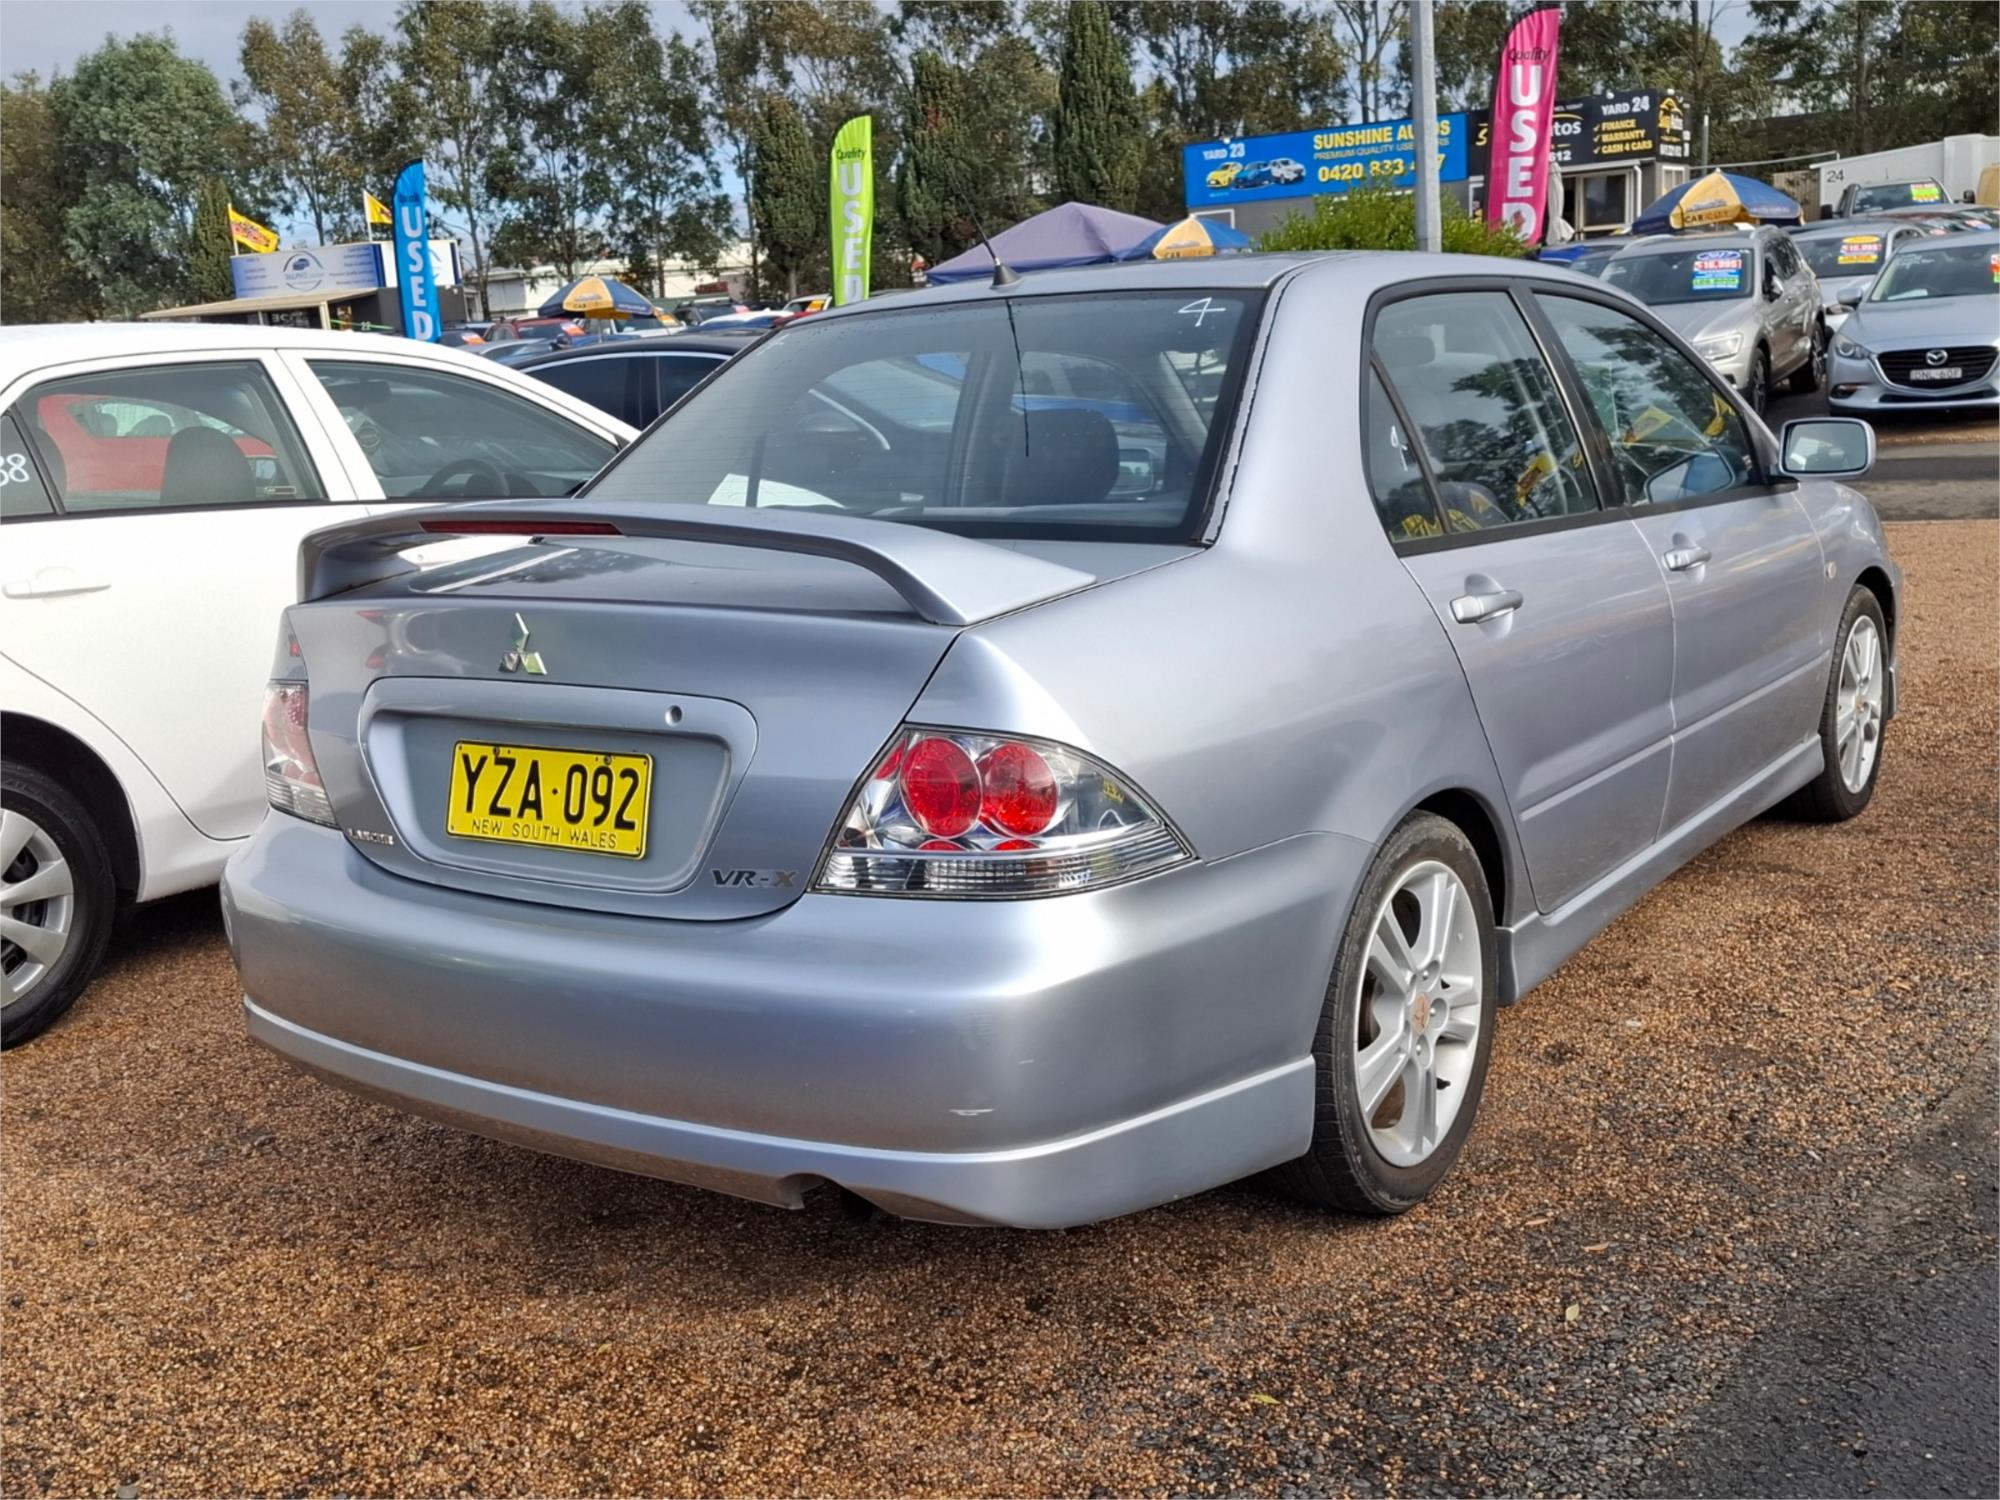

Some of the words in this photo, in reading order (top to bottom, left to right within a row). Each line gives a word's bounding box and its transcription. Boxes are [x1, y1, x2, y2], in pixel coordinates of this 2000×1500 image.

[1507, 47, 1551, 65] Quality
[1601, 102, 1630, 115] YARD
[1632, 95, 1651, 112] 24
[1601, 119, 1637, 131] FINANCE
[1313, 126, 1393, 150] SUNSHINE
[1601, 129, 1646, 143] WARRANTY
[836, 147, 866, 161] Quality
[1202, 148, 1228, 160] YARD
[1229, 142, 1246, 159] 23
[1313, 148, 1355, 160] PREMIUM
[1356, 143, 1394, 156] QUALITY
[1502, 65, 1542, 241] USED
[1601, 143, 1623, 154] CASH
[1631, 140, 1653, 151] CARS
[1318, 162, 1363, 182] 0420
[1370, 158, 1404, 177] 833
[1826, 168, 1844, 183] 24
[1684, 214, 1704, 223] CAR
[840, 162, 864, 304] USED
[401, 206, 434, 341] USED
[1178, 296, 1226, 327] 4
[472, 818, 503, 836] NEW
[512, 822, 561, 842] SOUTH
[570, 830, 618, 850] WALES
[711, 868, 798, 887] VR-X
